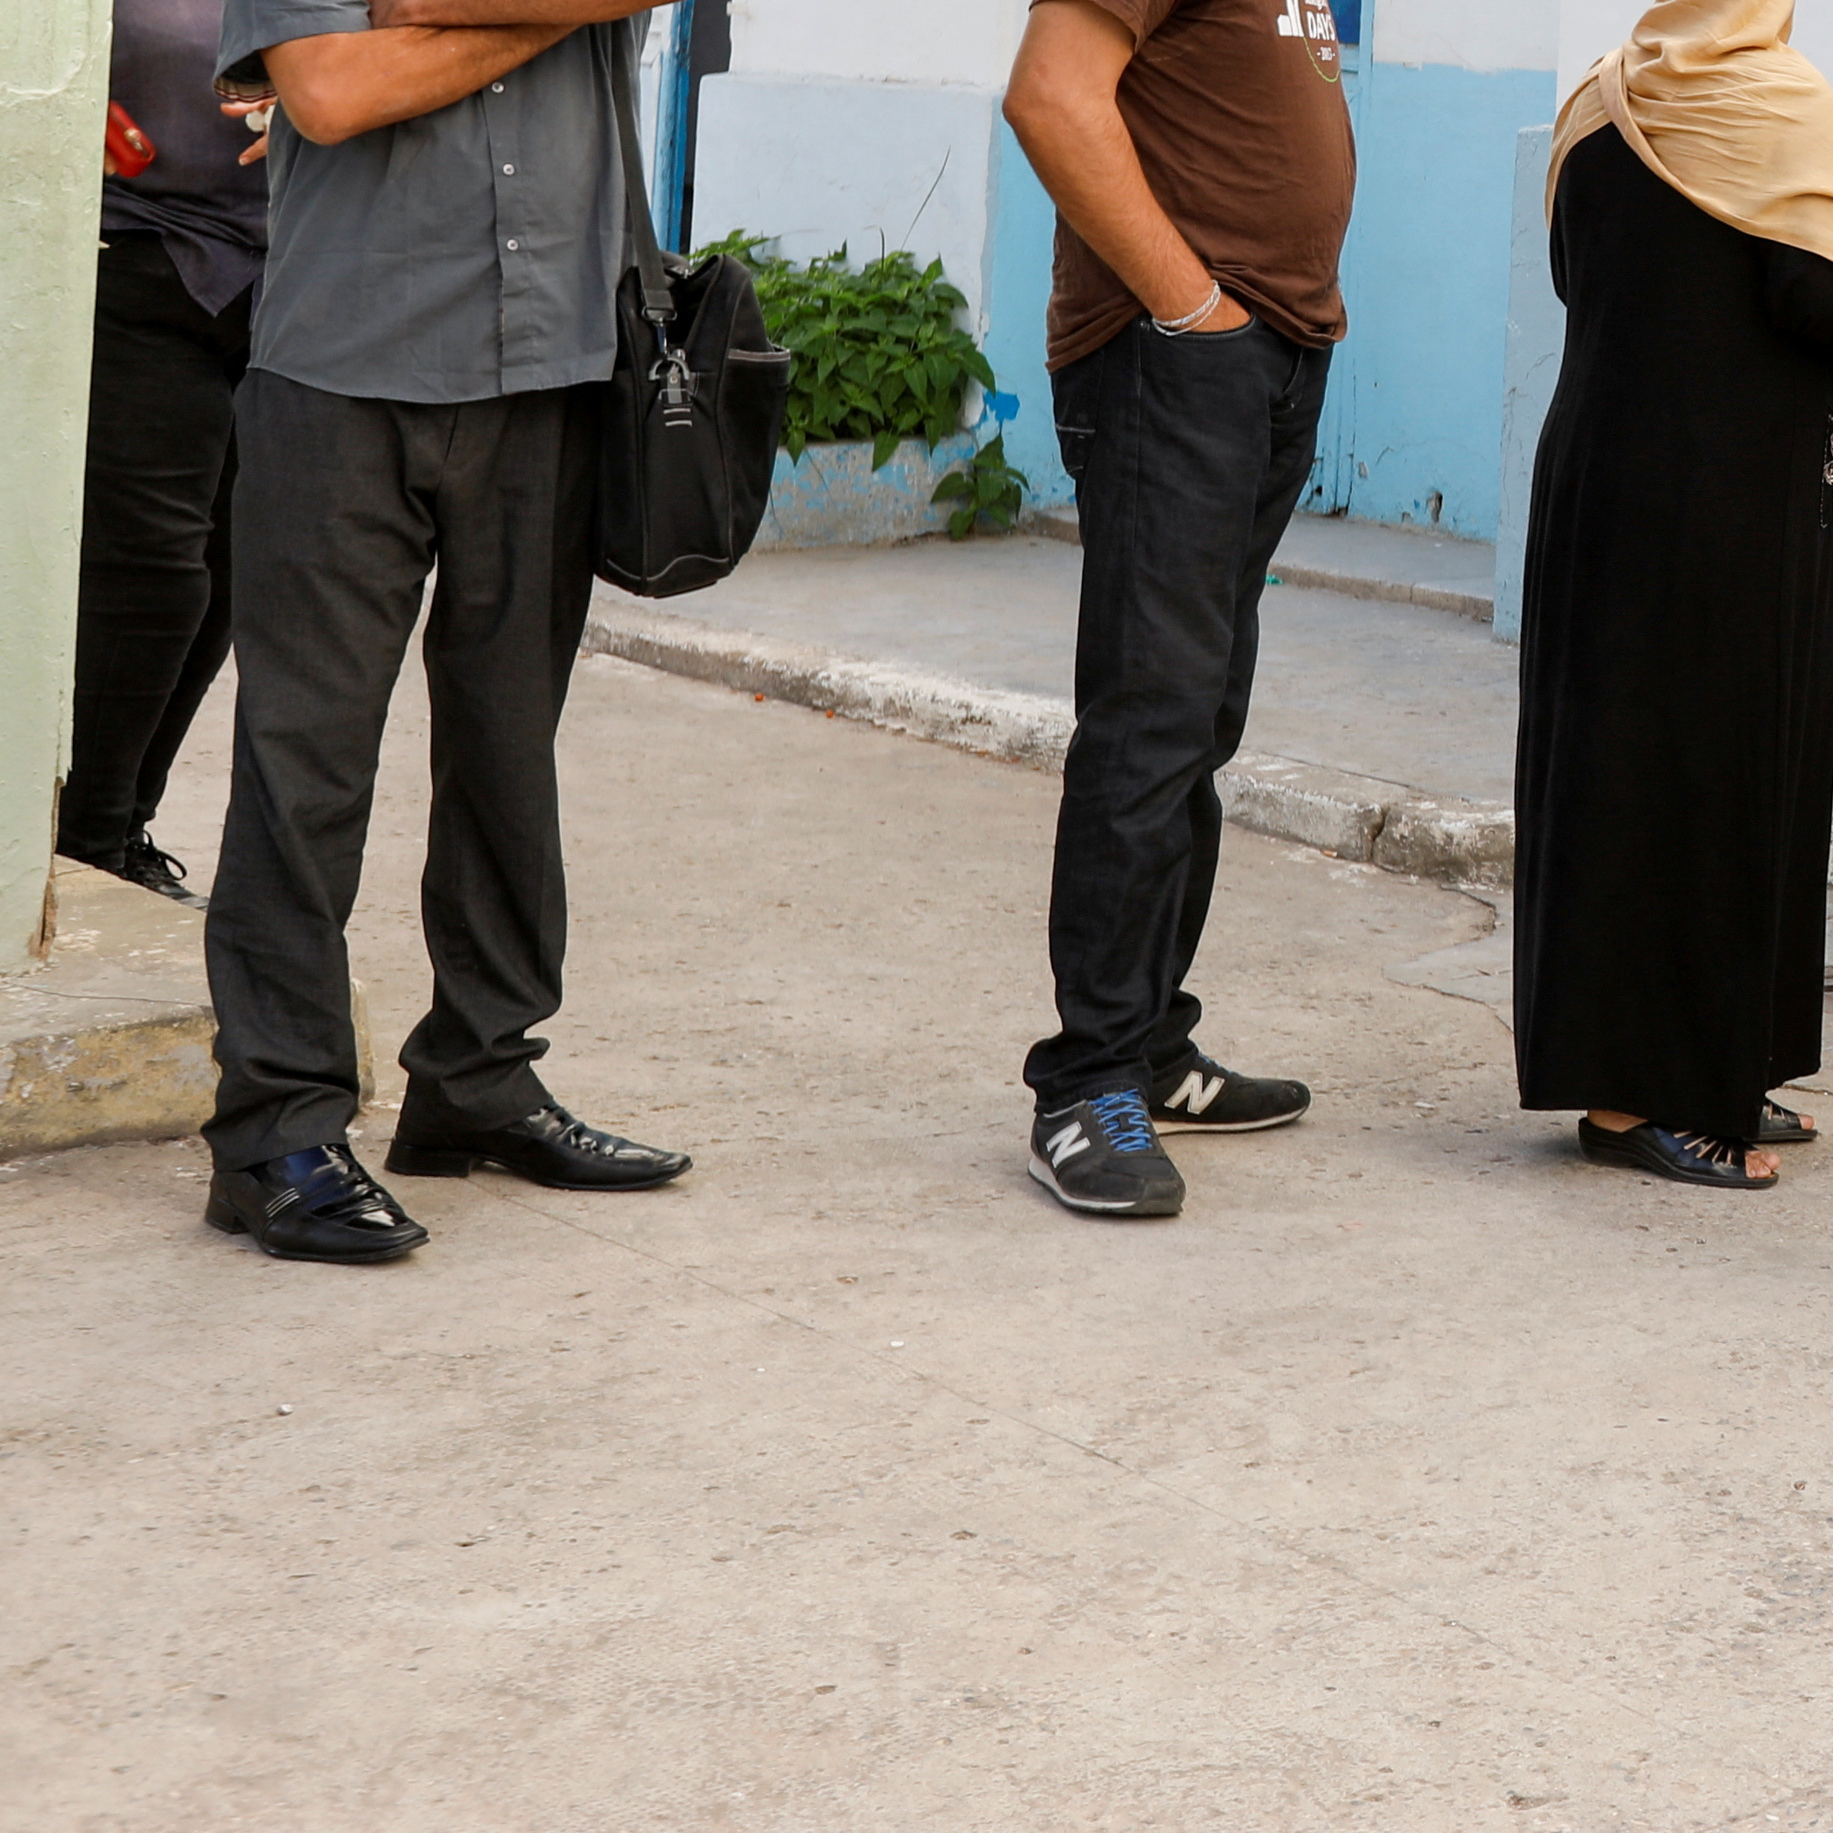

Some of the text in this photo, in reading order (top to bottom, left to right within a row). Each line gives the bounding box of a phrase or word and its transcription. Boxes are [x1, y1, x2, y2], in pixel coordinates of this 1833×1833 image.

[1306, 11, 1335, 41] DAYS
[1164, 1070, 1225, 1115] N
[1046, 1120, 1091, 1169] N
